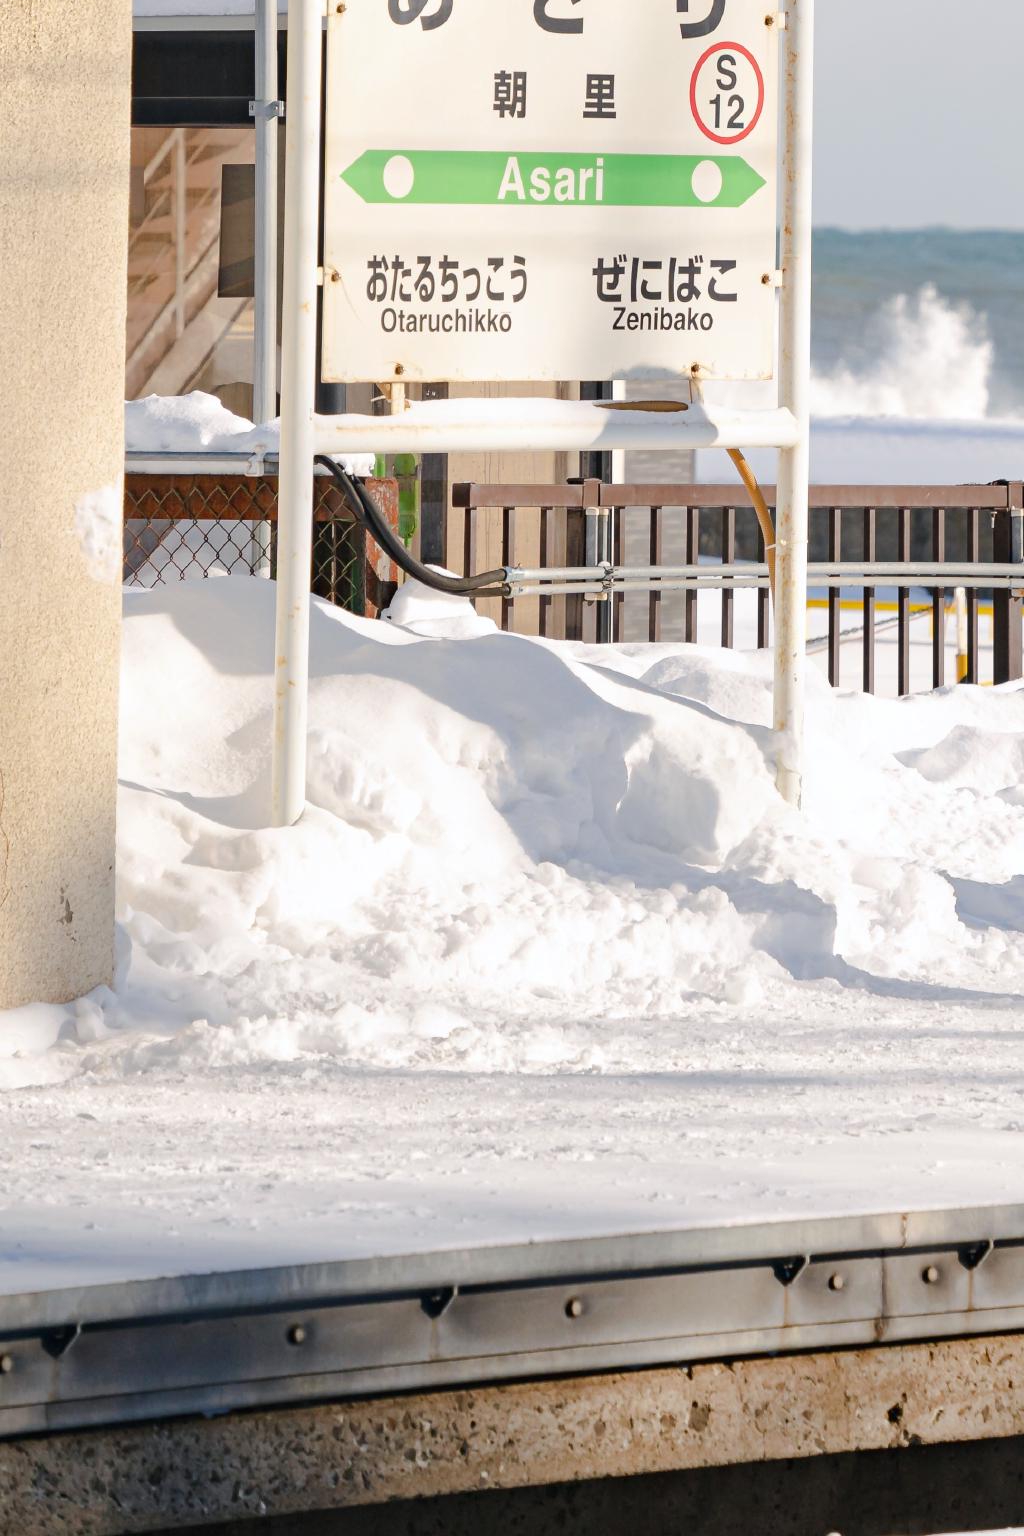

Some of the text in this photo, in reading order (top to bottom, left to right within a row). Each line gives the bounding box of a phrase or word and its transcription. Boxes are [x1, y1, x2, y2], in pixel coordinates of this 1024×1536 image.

[715, 54, 738, 91] S
[493, 70, 617, 119] 朝里
[709, 94, 745, 130] 12
[497, 156, 605, 202] Asari
[366, 254, 528, 303] おたるちっこう
[592, 254, 738, 304] ぜにばこ
[380, 307, 513, 333] Otaruchikko
[612, 307, 714, 332] Zenibako
